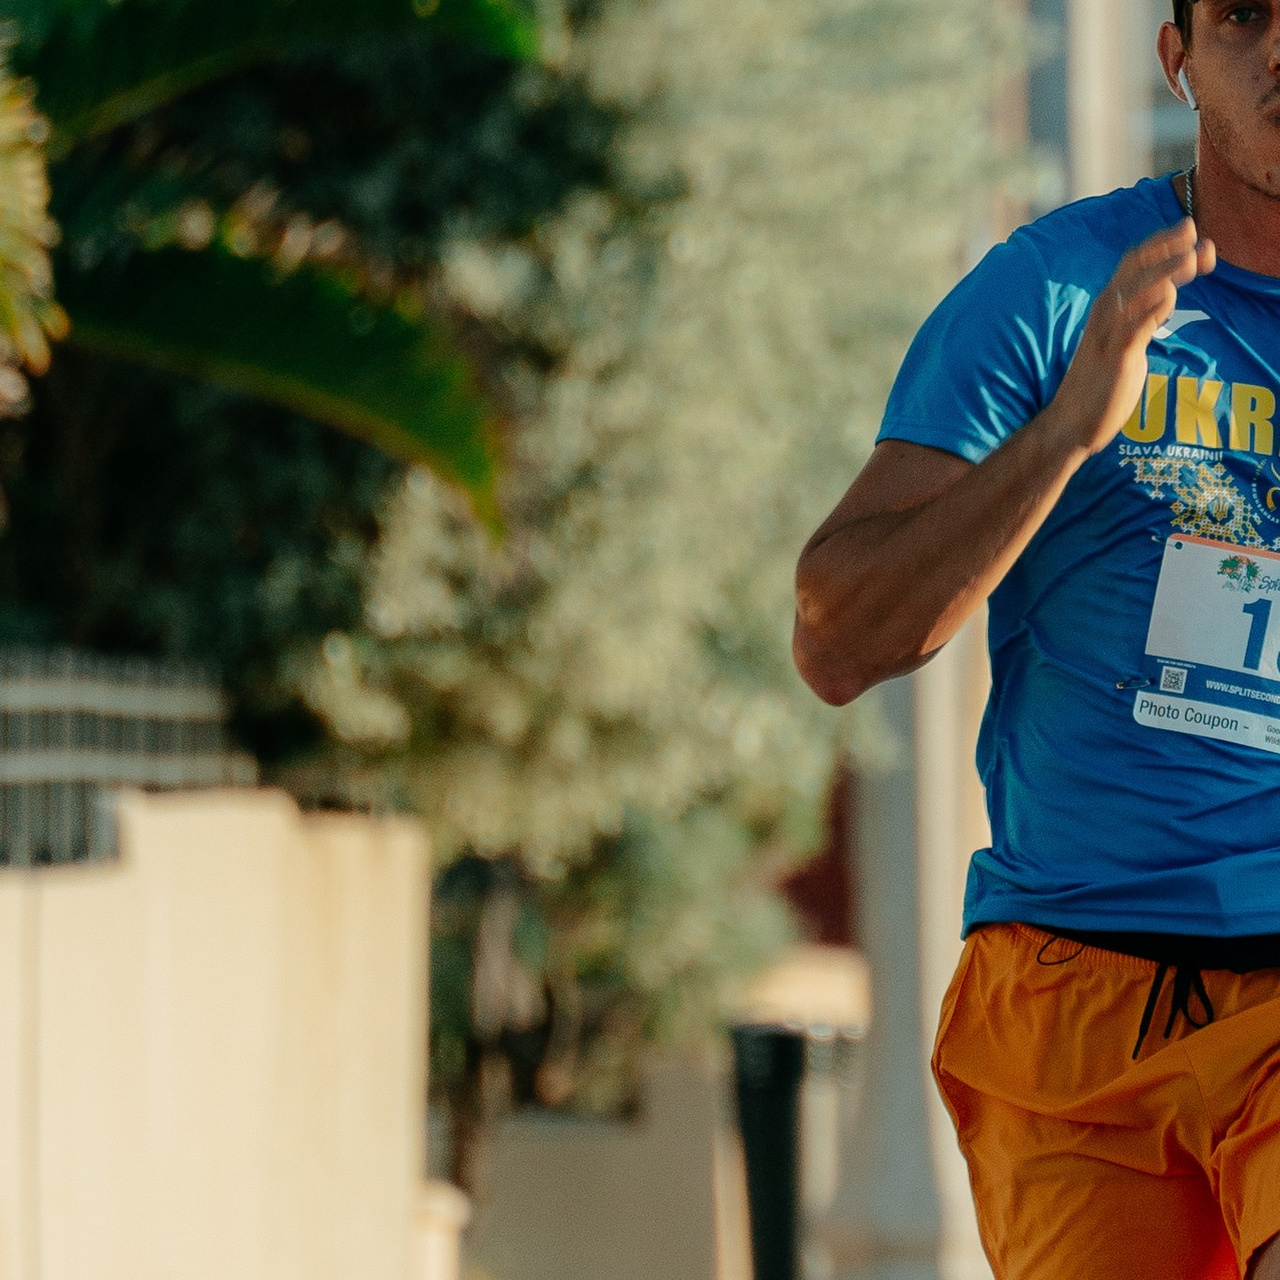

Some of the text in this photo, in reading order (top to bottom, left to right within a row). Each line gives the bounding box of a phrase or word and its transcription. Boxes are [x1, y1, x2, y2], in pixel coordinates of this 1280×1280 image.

[1118, 444, 1162, 456] SLAVA
[1139, 699, 1180, 720] Photo
[1184, 707, 1239, 732] Coupon
